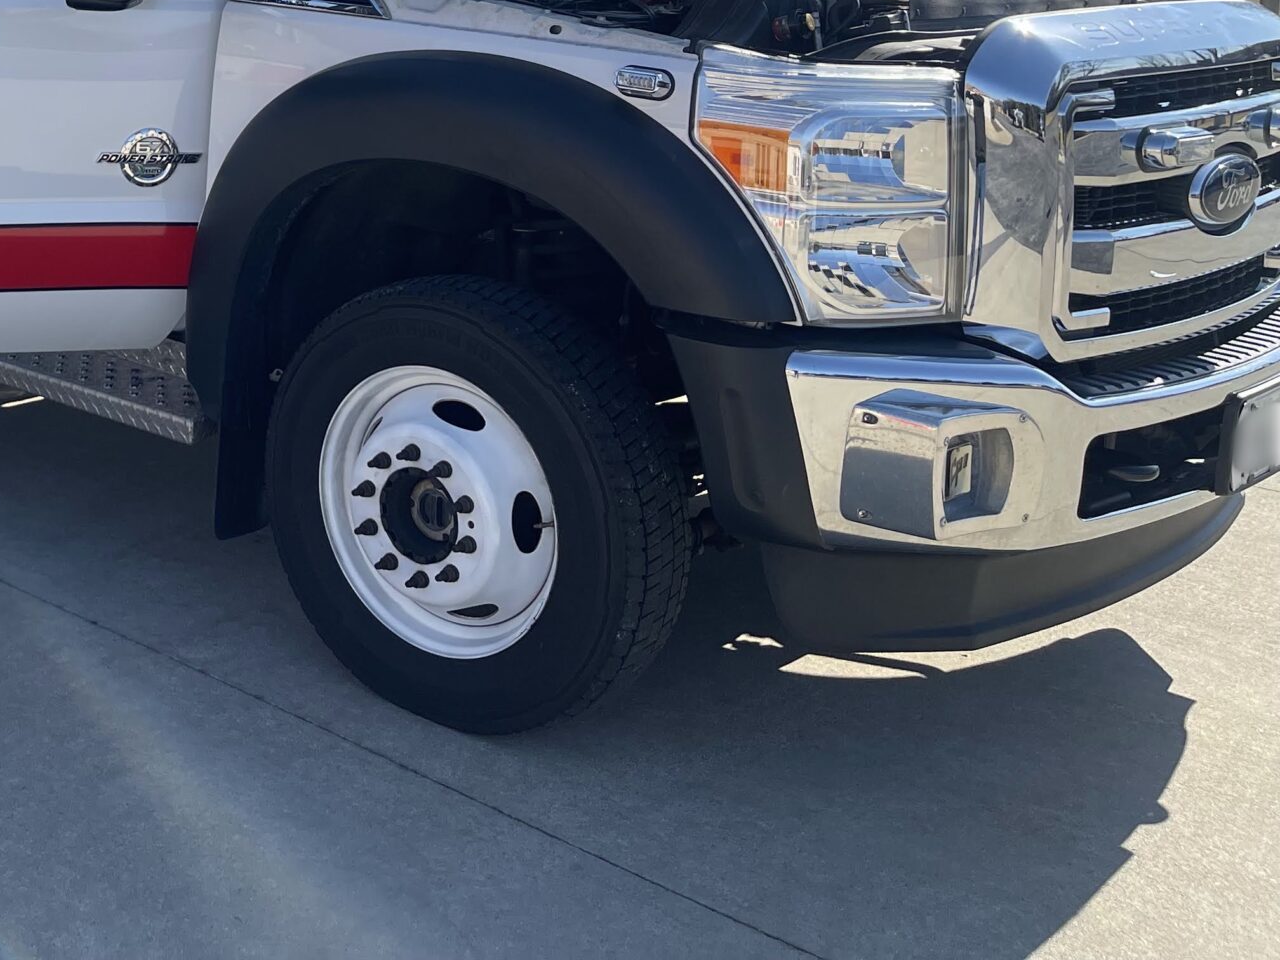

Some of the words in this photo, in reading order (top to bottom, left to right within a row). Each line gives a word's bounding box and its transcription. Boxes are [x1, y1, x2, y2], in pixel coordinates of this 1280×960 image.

[136, 141, 165, 154] 6.7
[97, 152, 147, 164] POWER
[1217, 167, 1253, 211] Ford
